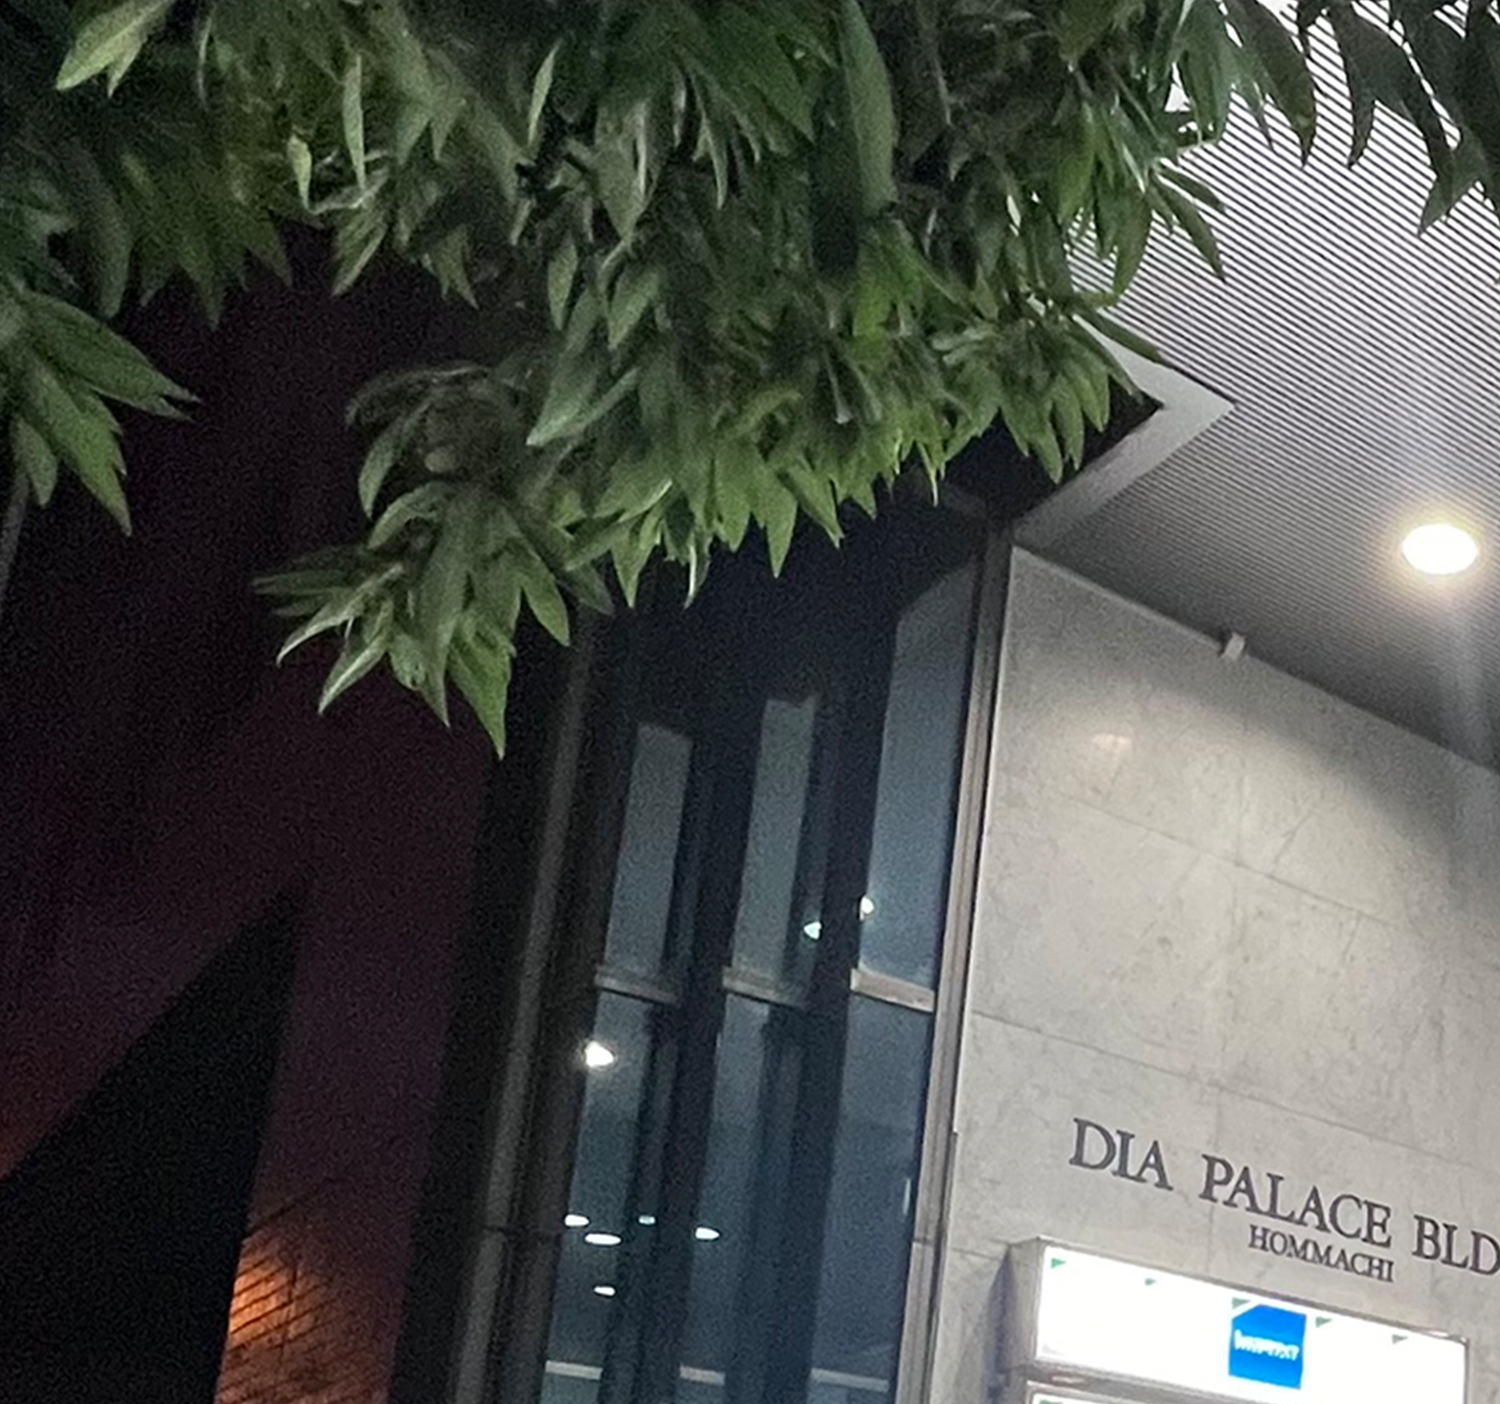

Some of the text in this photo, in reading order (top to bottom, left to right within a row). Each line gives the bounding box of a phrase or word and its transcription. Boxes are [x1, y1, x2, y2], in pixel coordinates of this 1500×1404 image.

[1069, 1117, 1174, 1191] DIA
[1198, 1153, 1393, 1248] PALACE
[1247, 1224, 1395, 1283] HOMMACHI
